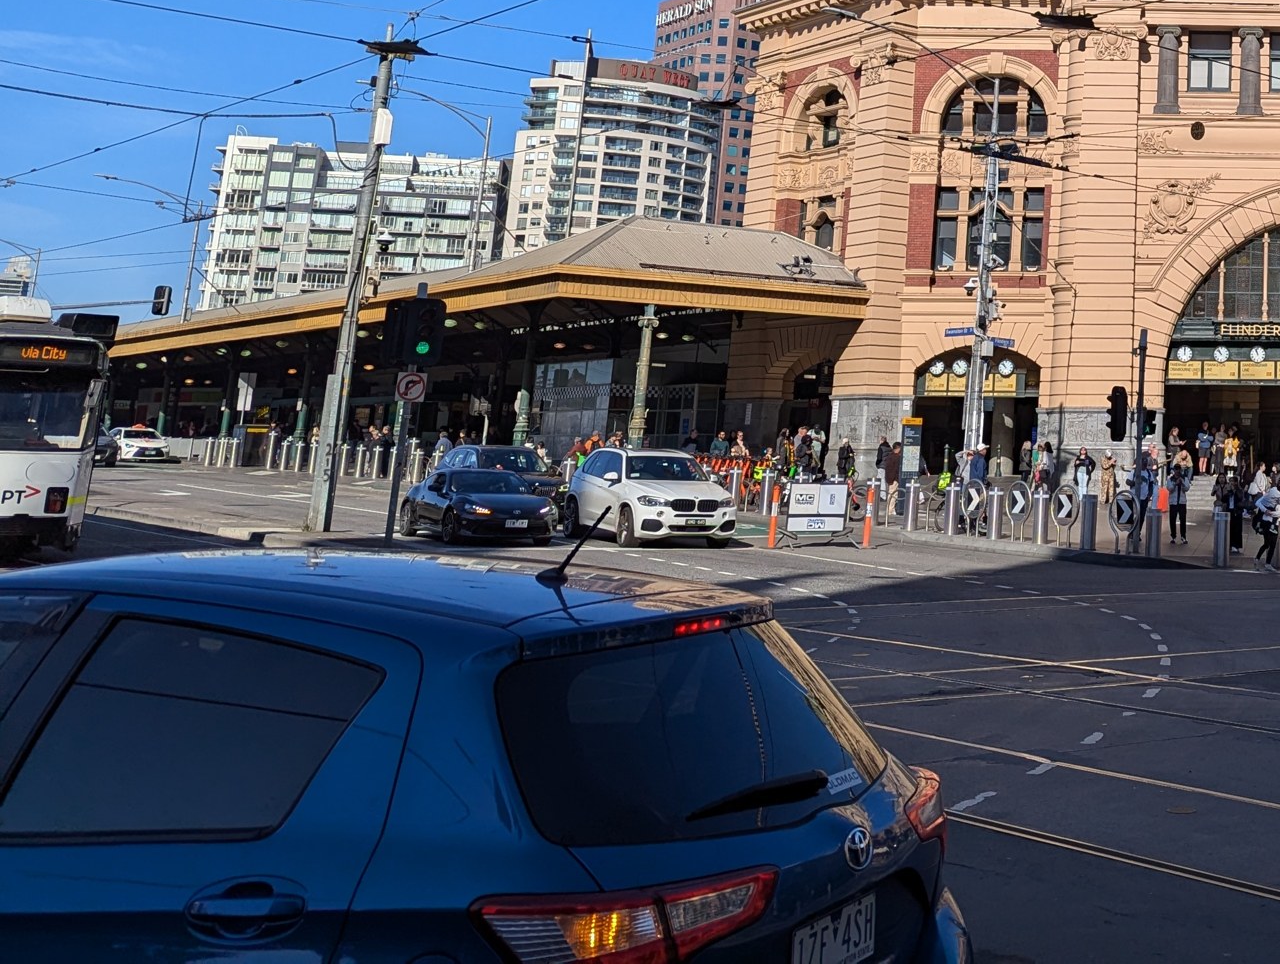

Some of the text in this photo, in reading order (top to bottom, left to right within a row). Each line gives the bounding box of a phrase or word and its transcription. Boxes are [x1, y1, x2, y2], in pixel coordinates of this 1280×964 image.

[656, 3, 692, 27] HERALD
[620, 63, 657, 81] QUAY
[21, 346, 67, 360] via City
[795, 494, 815, 502] MC
